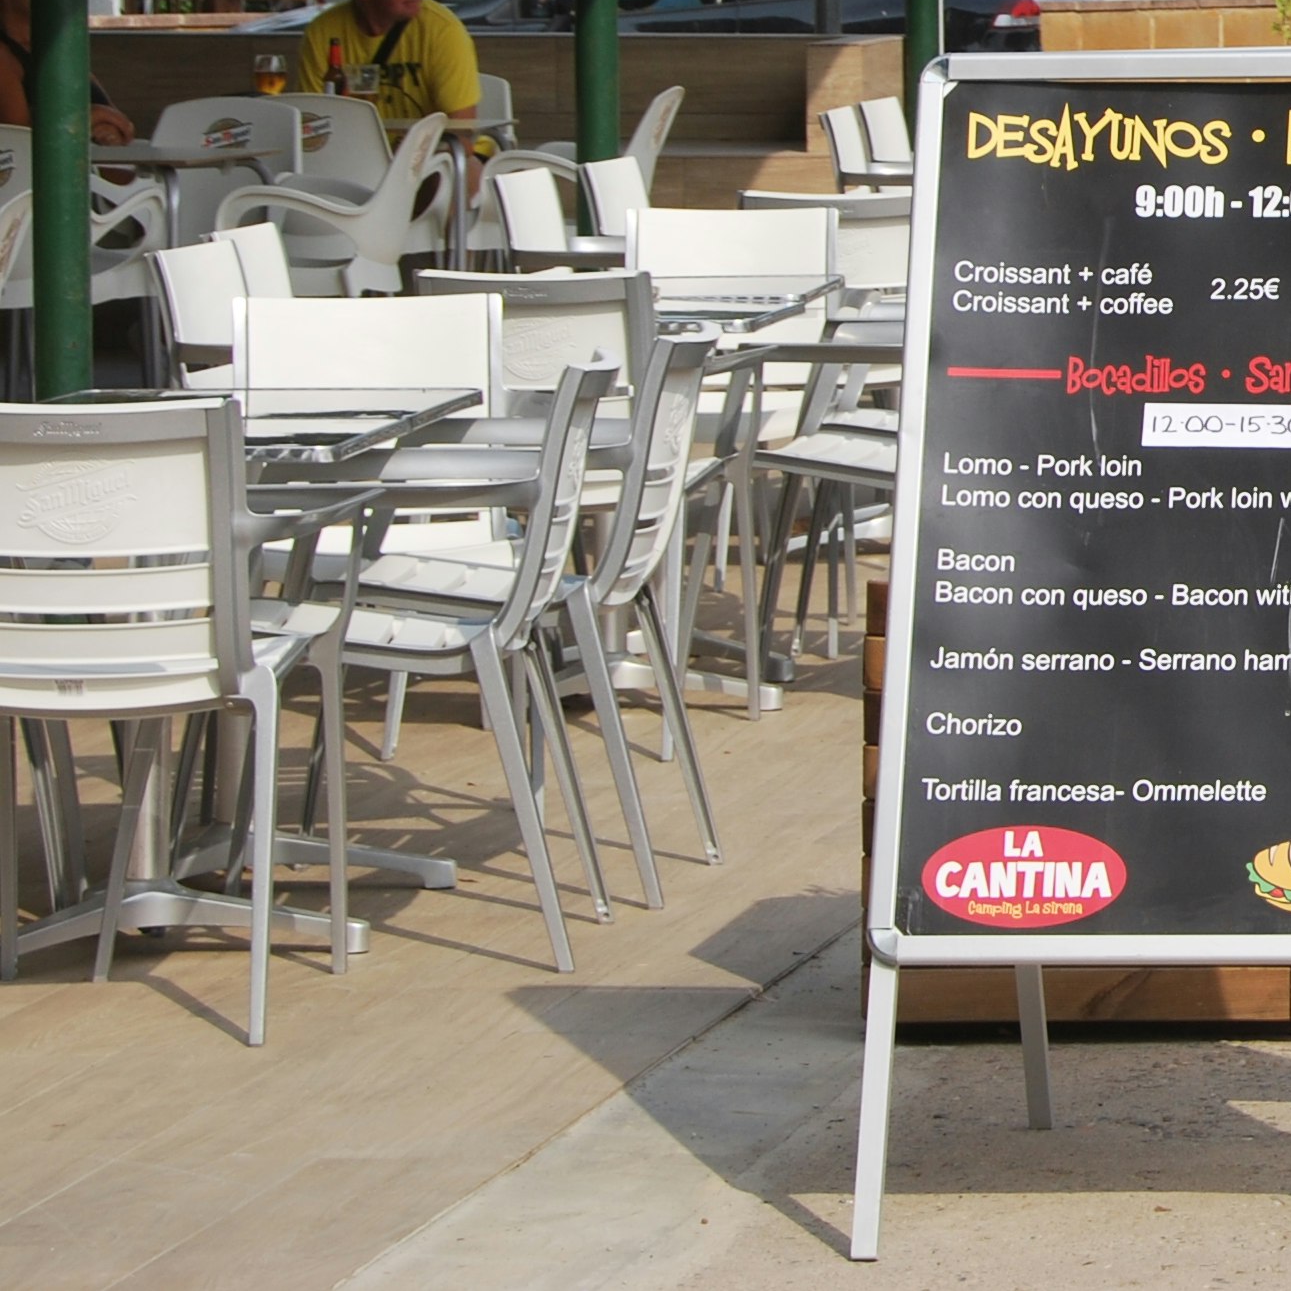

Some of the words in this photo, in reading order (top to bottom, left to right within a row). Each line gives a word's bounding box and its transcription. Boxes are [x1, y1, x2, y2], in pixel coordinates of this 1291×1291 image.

[967, 102, 1233, 171] DESAYUNOS
[1135, 184, 1225, 219] 9:00h
[953, 260, 1071, 285] Croissant
[1078, 266, 1094, 282] +
[1100, 262, 1153, 285] café
[1210, 277, 1281, 300] 2.25€
[952, 289, 1070, 314] Croissant
[1076, 295, 1093, 311] +
[1099, 292, 1174, 315] coffee
[1066, 354, 1207, 396] Bocadillos
[943, 451, 1013, 476] Lomo
[1036, 454, 1093, 477] Pork
[1100, 454, 1142, 477] loin
[941, 483, 1011, 508] Lomo
[1017, 491, 1062, 509] con
[1069, 491, 1144, 514] queso
[1168, 486, 1224, 509] Pork
[1231, 486, 1273, 509] loin
[937, 548, 1016, 572] Bacon
[934, 582, 1014, 605] Bacon
[1020, 588, 1066, 606] con
[1072, 588, 1148, 611] queso
[1171, 583, 1249, 606] Bacon
[929, 646, 1014, 671] Jamón
[1021, 653, 1115, 671] serrano
[1138, 648, 1237, 671] Serrano
[925, 711, 1023, 736] Chorizo
[921, 777, 1002, 802] Tortilla
[1132, 779, 1267, 802] Ommelette
[1003, 830, 1044, 858] LA
[935, 861, 1112, 899] CANTINA
[967, 900, 1023, 918] Camping
[1025, 900, 1040, 915] La
[1042, 900, 1083, 915] sirena
